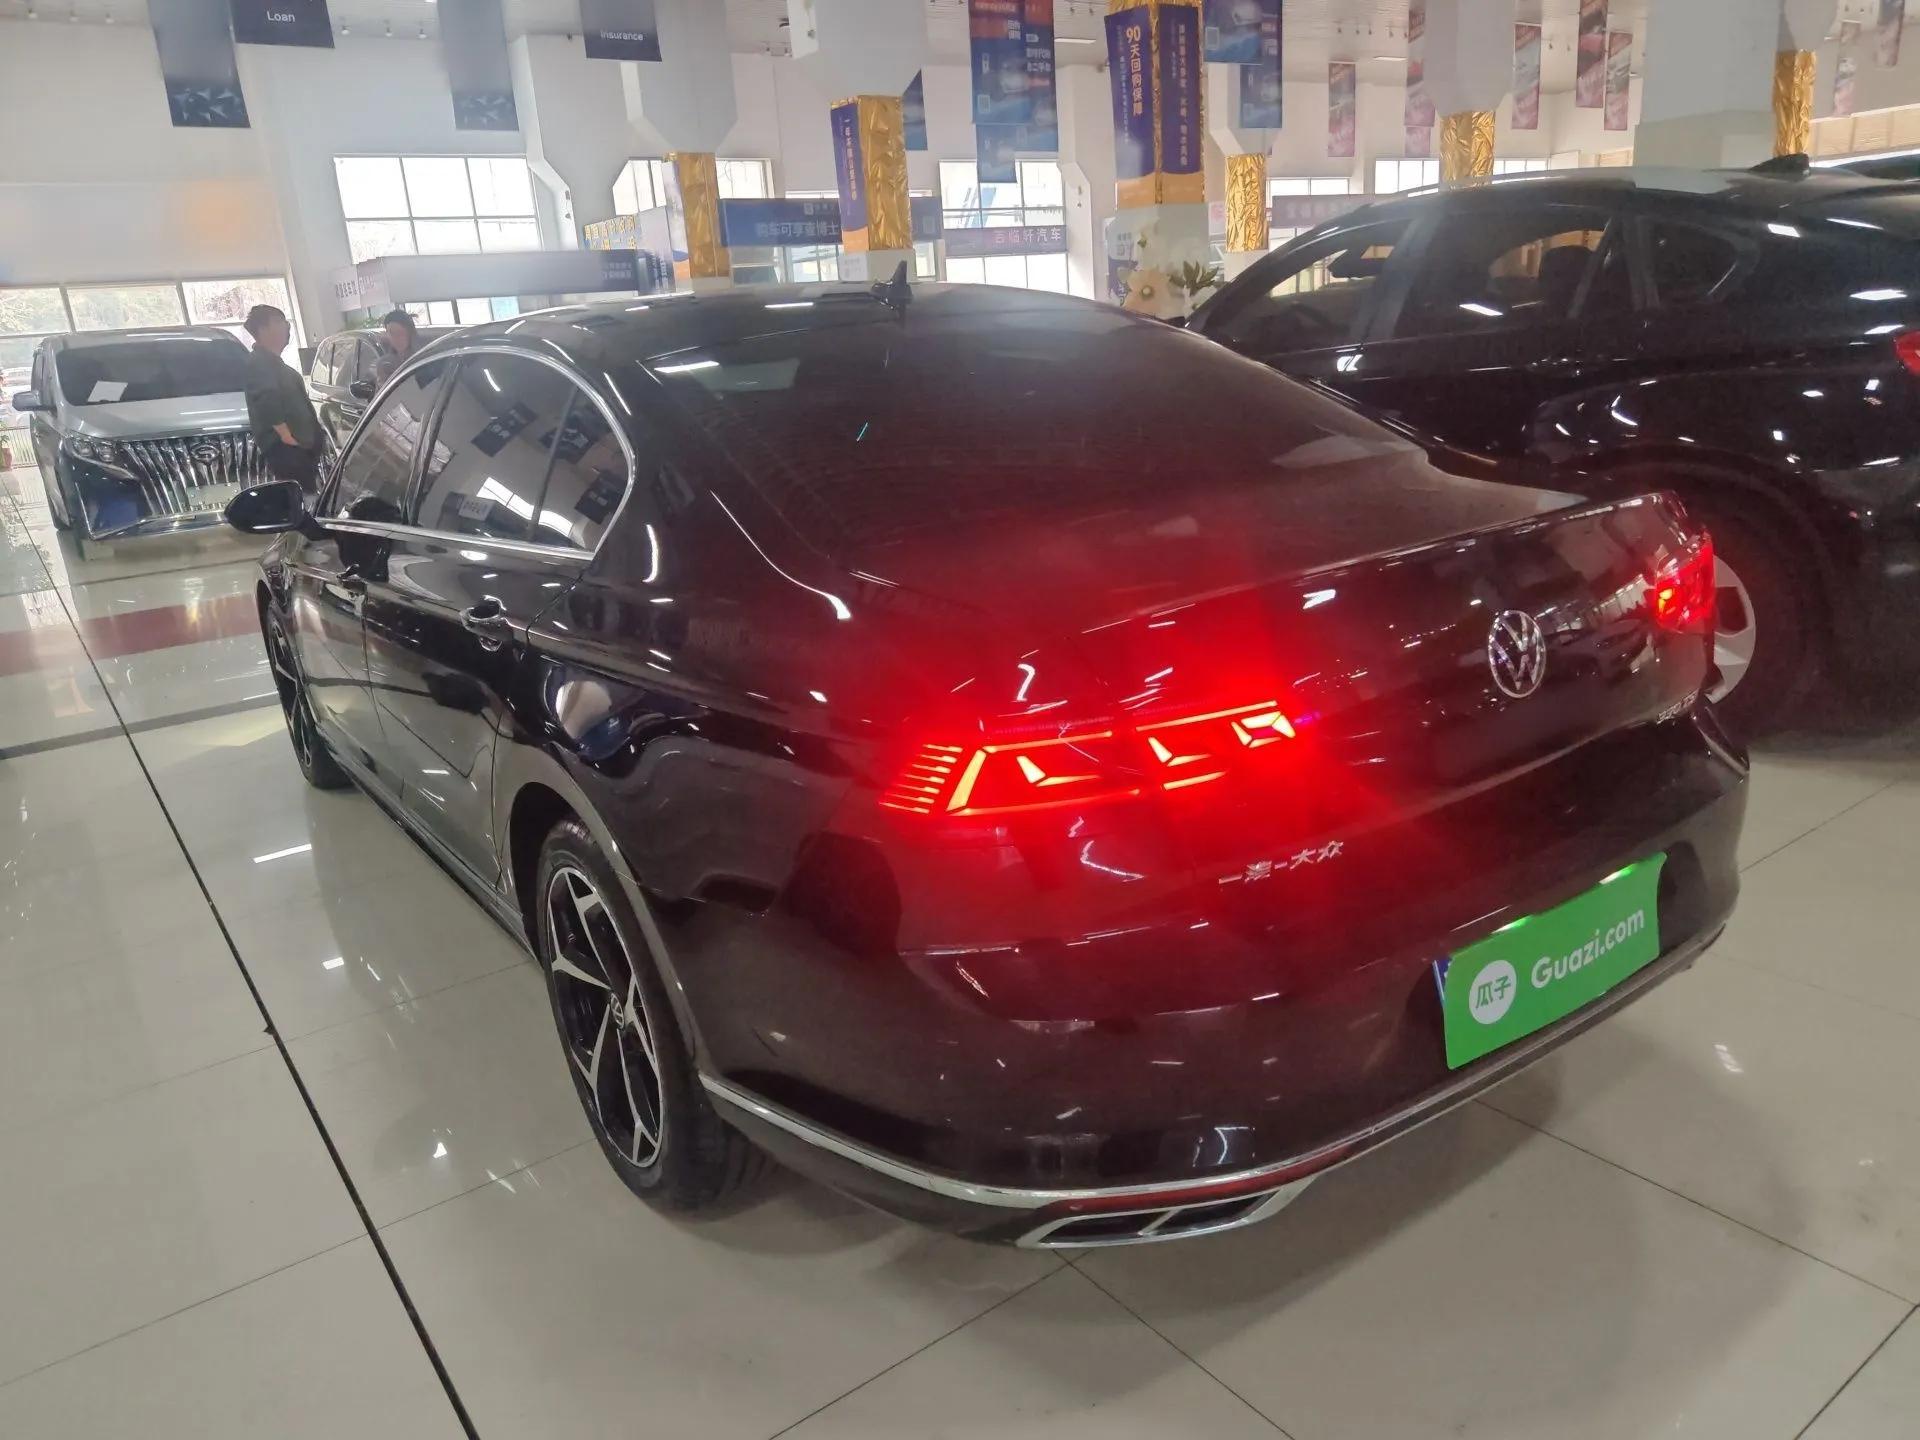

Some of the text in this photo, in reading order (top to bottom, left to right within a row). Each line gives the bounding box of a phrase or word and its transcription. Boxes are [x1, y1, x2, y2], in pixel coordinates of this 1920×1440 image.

[266, 10, 296, 23] Loan
[600, 30, 645, 42] Insurance
[1125, 24, 1144, 117] 90天回购保障
[1530, 908, 1646, 989] Guazi.com
[1474, 974, 1512, 1009] 瓜子
